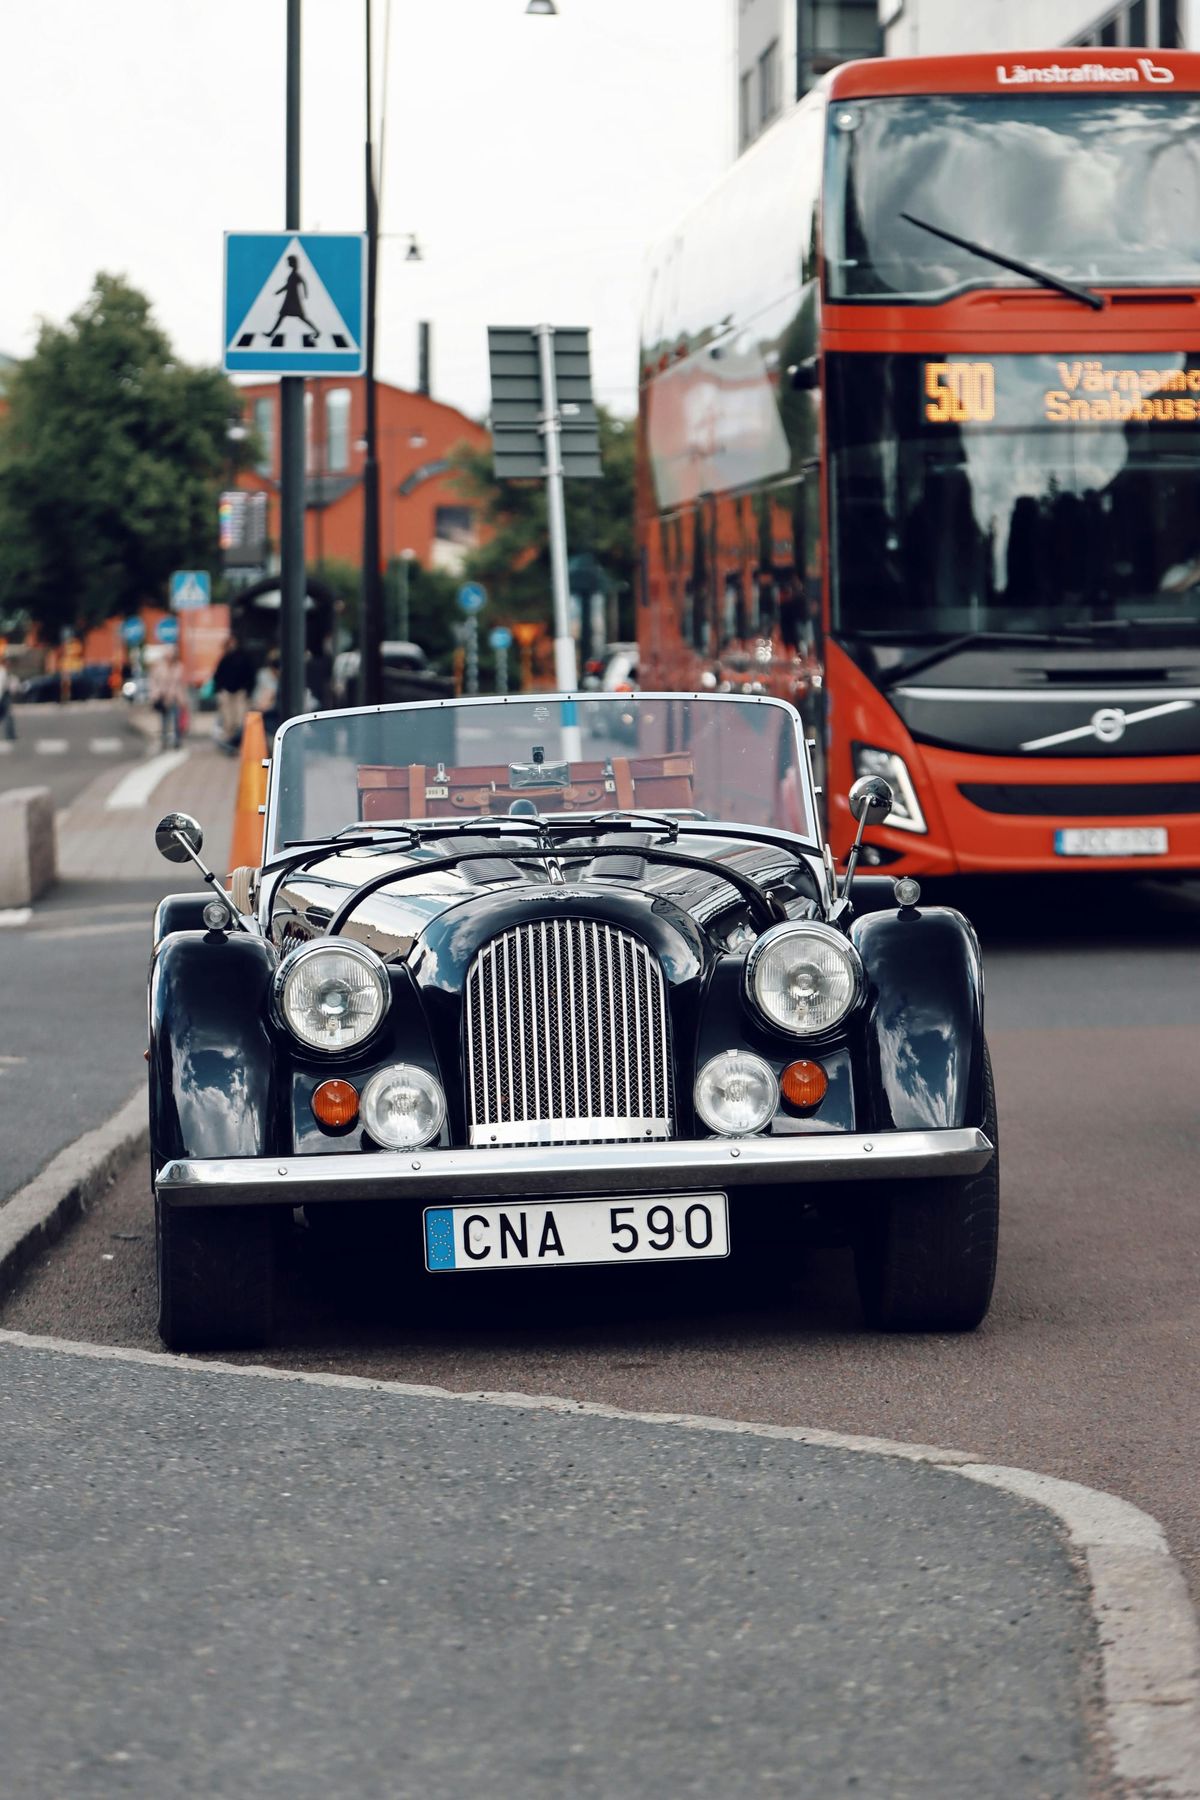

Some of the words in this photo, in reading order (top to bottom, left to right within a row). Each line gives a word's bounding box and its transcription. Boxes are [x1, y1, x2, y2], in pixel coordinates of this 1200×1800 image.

[996, 64, 1139, 85] Länstrafiken
[924, 362, 995, 422] 500
[1044, 390, 1200, 421] Snabbus
[463, 1211, 565, 1260] CNA
[610, 1203, 713, 1253] 590
